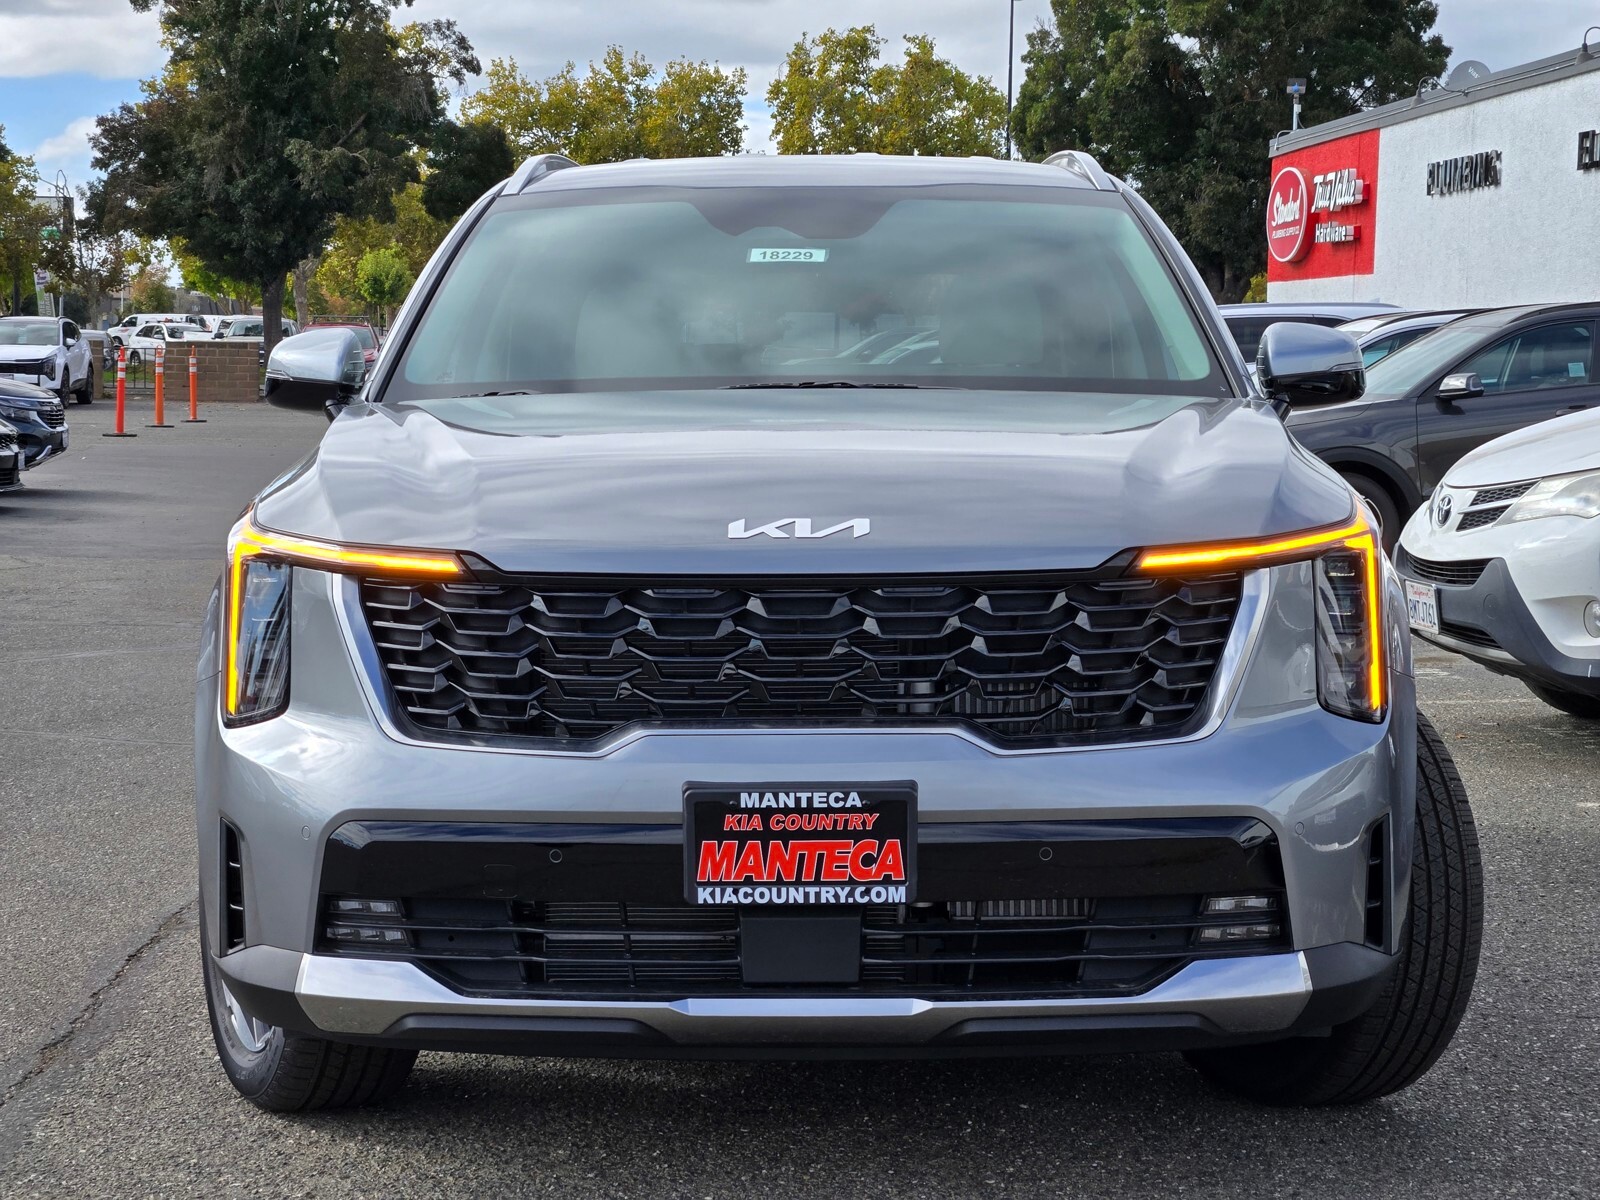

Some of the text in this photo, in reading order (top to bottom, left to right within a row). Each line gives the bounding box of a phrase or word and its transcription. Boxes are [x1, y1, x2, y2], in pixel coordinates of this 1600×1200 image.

[1427, 150, 1502, 196] PLUMBING
[1315, 221, 1346, 243] Hardware
[759, 251, 813, 260] 18229
[740, 792, 862, 808] MANTECA
[723, 813, 879, 831] KIA COUNTRY
[697, 839, 905, 881] MANTECA
[697, 886, 906, 904] KIACOUNTRY.COM
